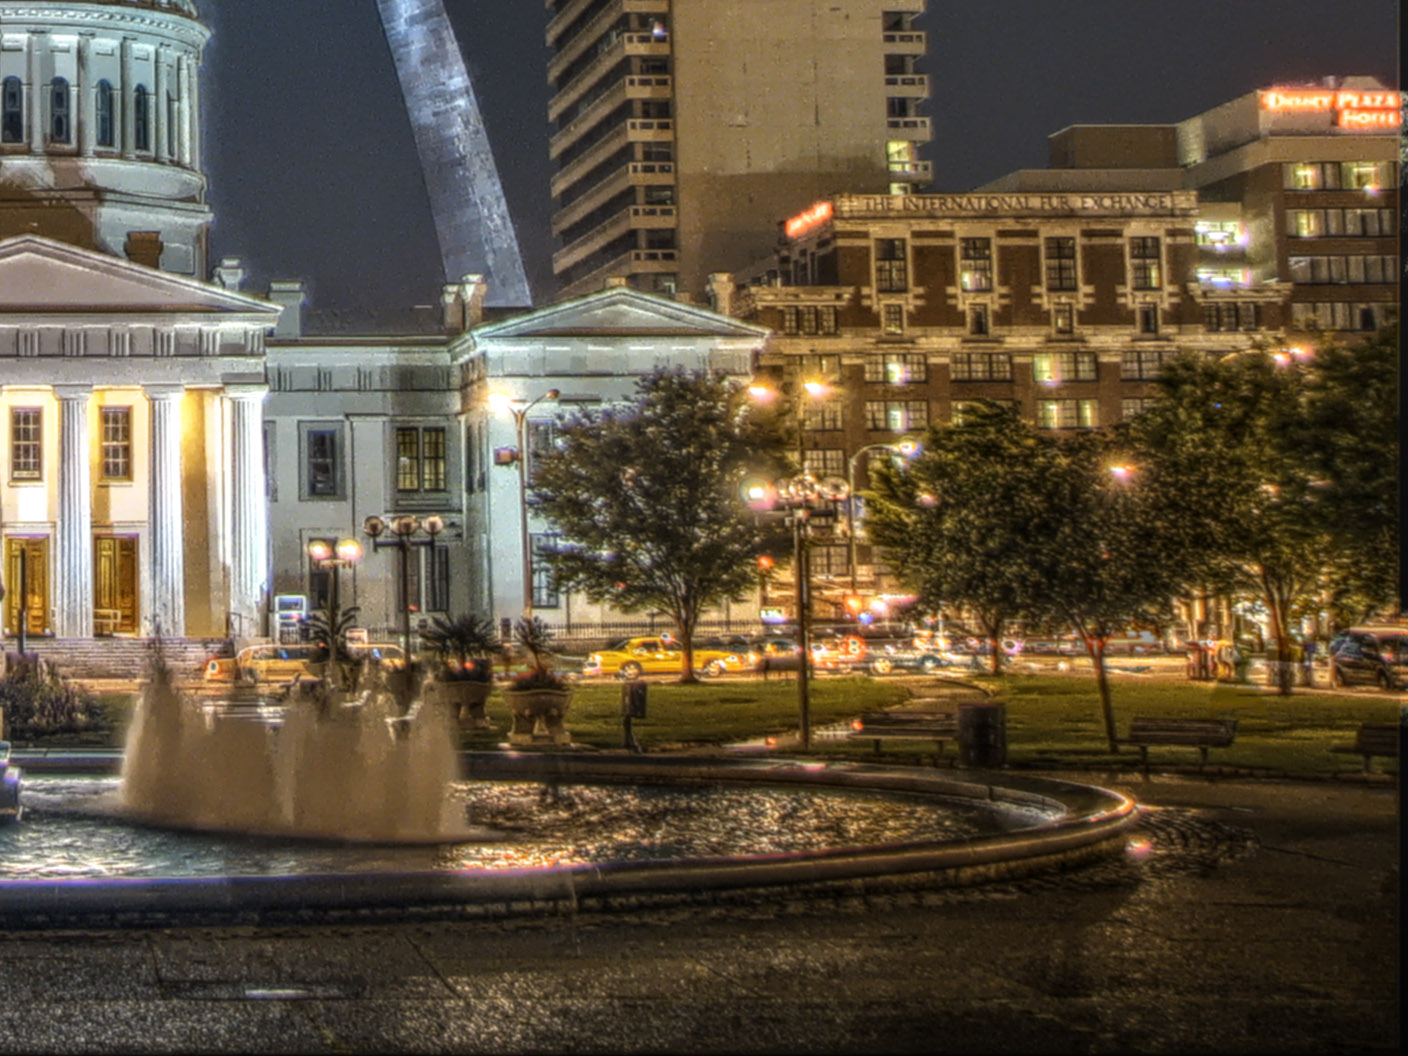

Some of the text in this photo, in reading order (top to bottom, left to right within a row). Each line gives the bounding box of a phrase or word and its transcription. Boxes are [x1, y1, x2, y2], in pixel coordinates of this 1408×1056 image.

[865, 195, 1170, 211] THE INTERNATIONAL FUR EXCHANGE
